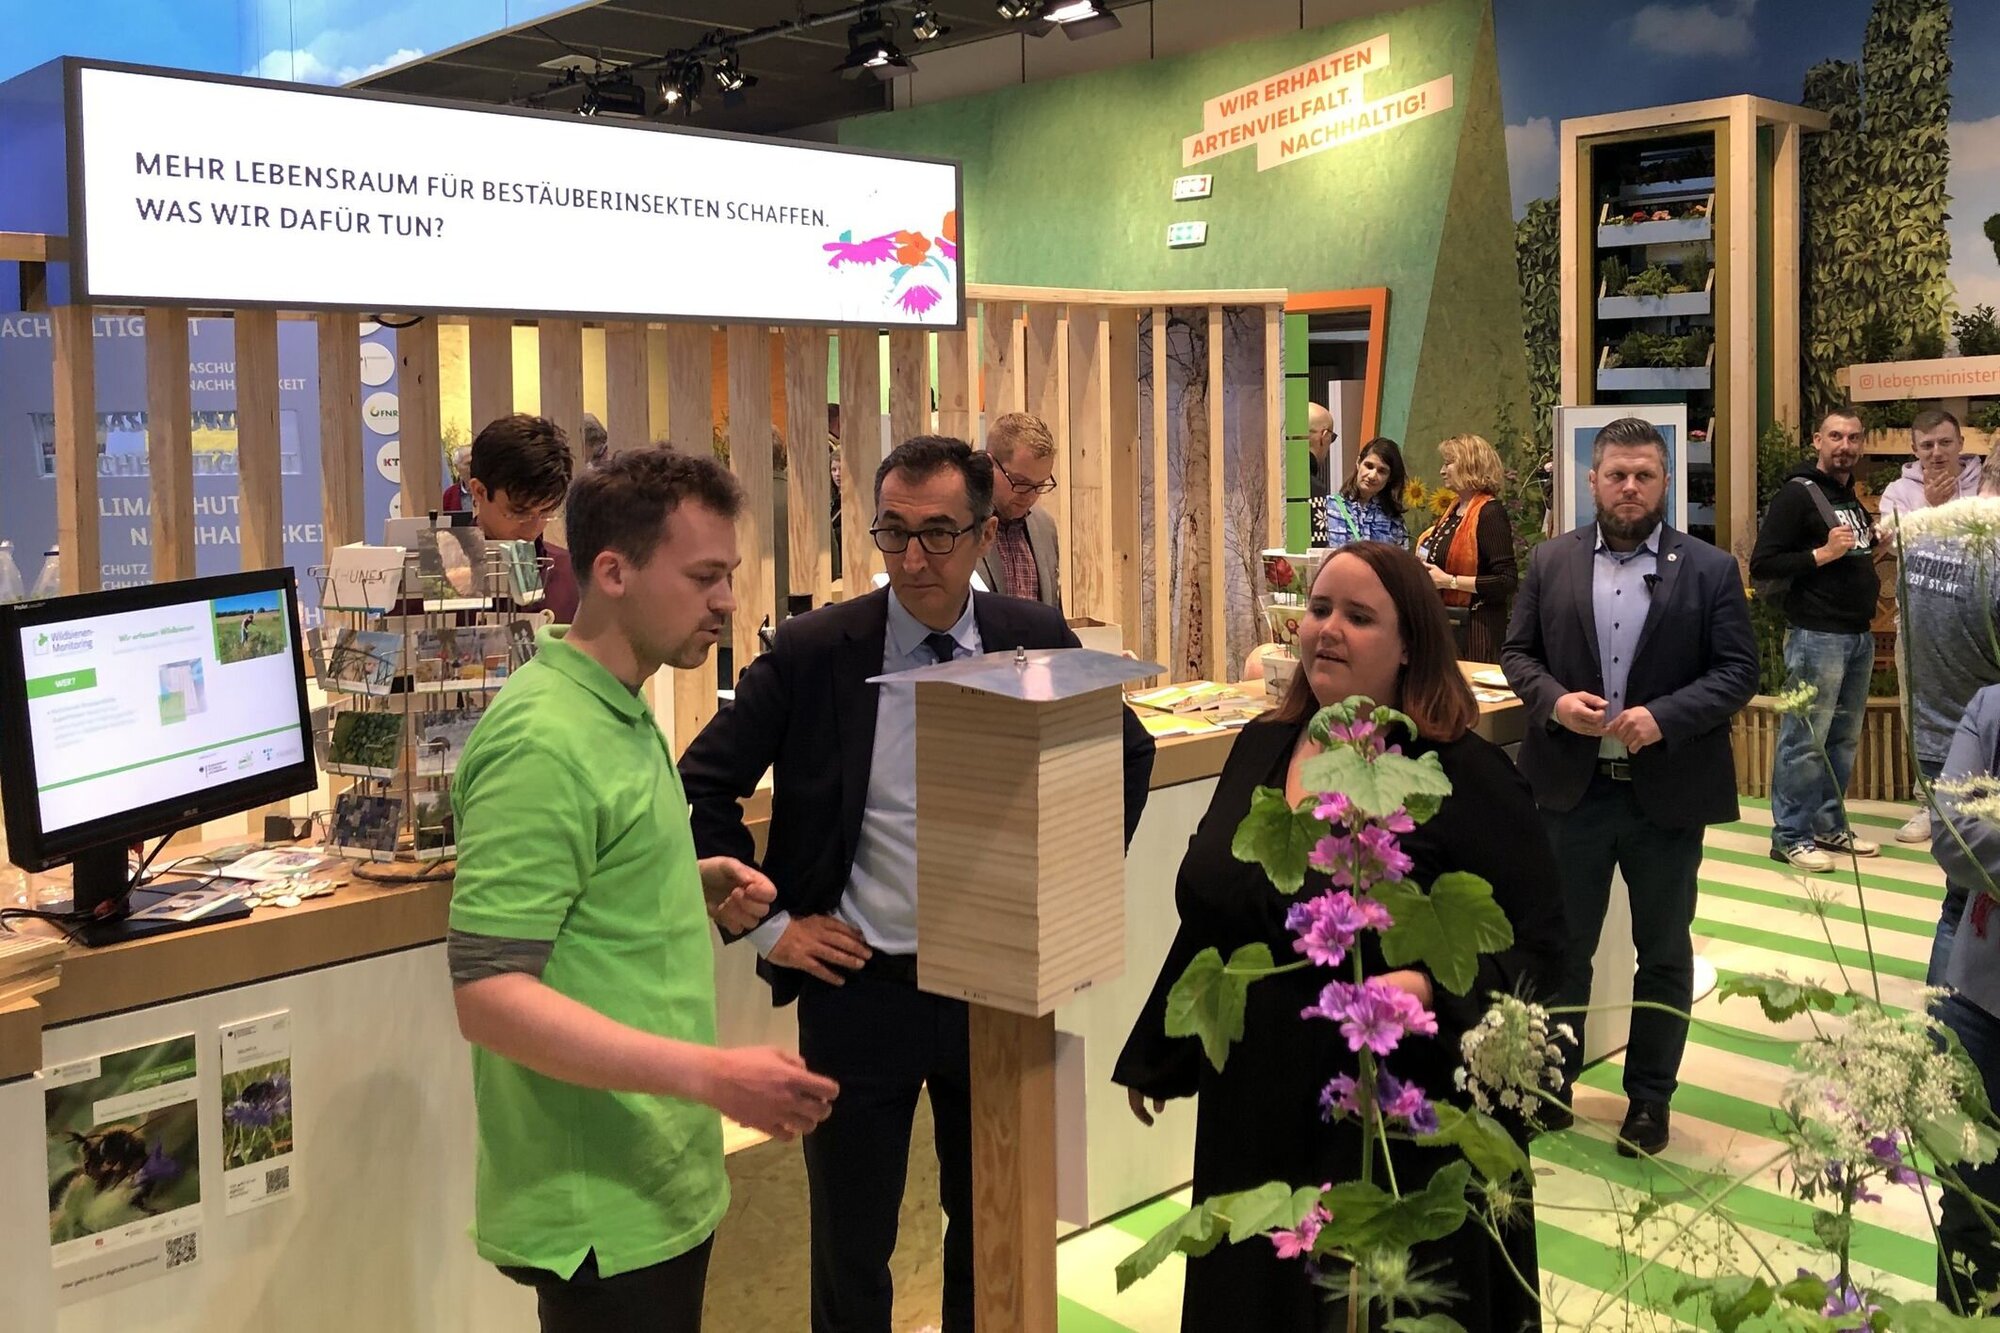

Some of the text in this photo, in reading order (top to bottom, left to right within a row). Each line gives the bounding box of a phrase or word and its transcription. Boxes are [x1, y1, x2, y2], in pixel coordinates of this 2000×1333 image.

[1219, 46, 1372, 118] WIR ERHALTEN
[1192, 87, 1353, 158] ARTENVIELFALT.
[1280, 91, 1426, 158] NACHHALTIG!
[136, 151, 830, 228] MEHR LEBENSRAUM FÜR BESTÄUBERINSEKTEN SCHAFFEN.
[136, 197, 445, 238] WAS WIR DAFÜR TUN?
[1878, 367, 2000, 389] lebensminister
[383, 457, 400, 467] KT
